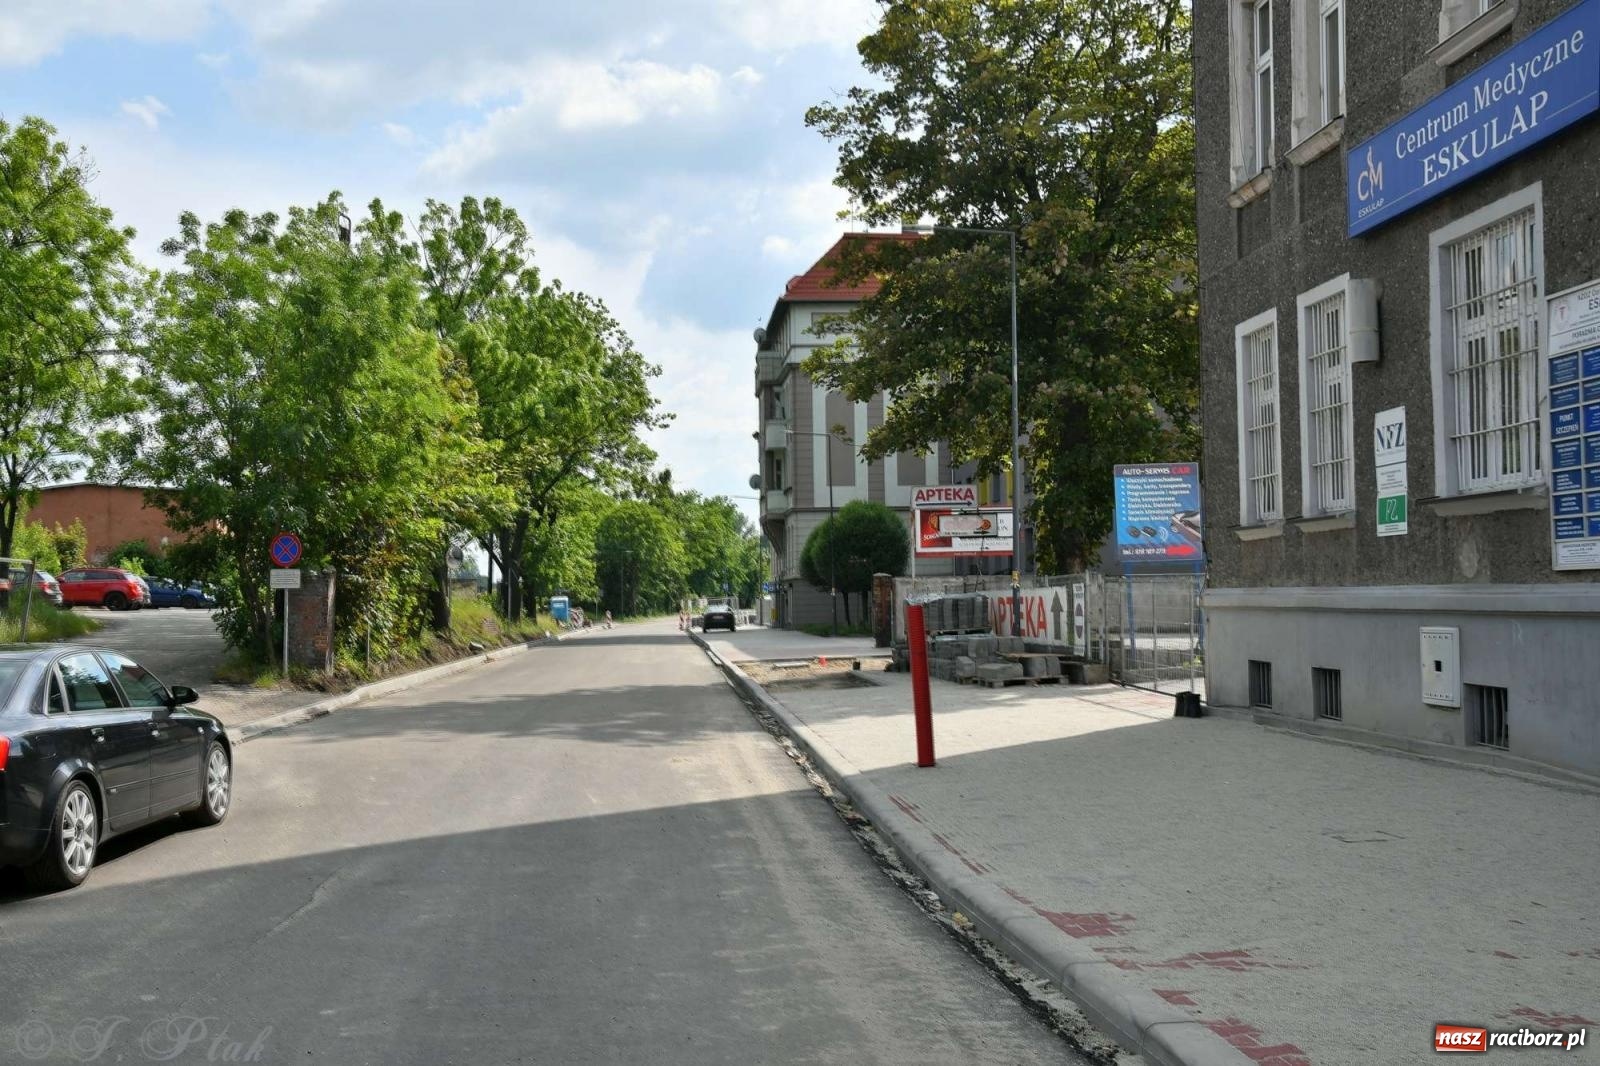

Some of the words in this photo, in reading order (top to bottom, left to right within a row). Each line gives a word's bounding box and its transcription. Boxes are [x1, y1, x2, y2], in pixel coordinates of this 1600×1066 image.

[1396, 102, 1469, 159] Centrum
[1473, 30, 1584, 114] Medyczne
[1421, 90, 1549, 187] ESKULAP
[1358, 198, 1384, 218] ESKULAP
[1376, 422, 1405, 453] NFZ
[1122, 467, 1170, 476] AUTO-SERWIS
[914, 487, 975, 501] APTEKA
